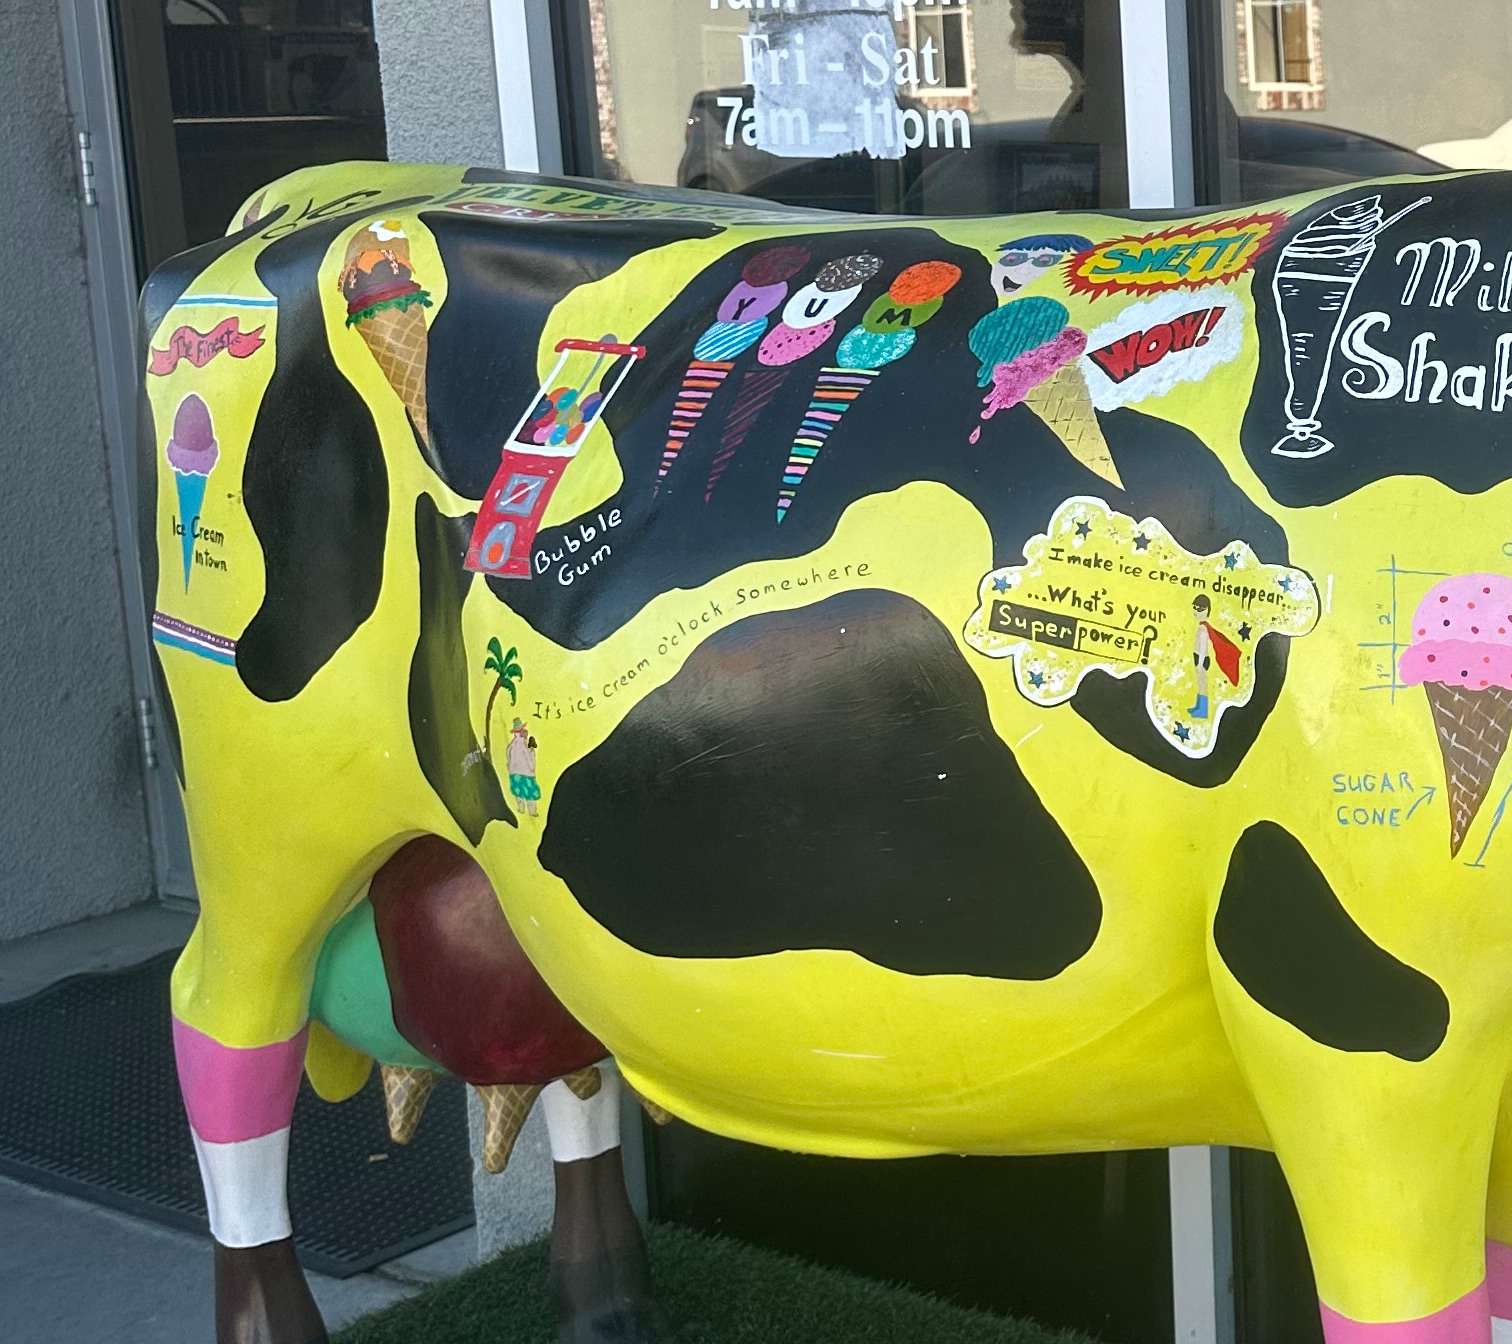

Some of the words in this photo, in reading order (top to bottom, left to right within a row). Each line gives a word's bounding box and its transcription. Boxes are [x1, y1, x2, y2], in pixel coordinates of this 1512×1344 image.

[738, 34, 811, 86] Fri
[860, 31, 941, 86] Sat
[716, 96, 811, 146] 7am
[854, 98, 973, 157] 11pm
[1087, 306, 1227, 384] WOW!
[191, 515, 225, 548] Cream
[535, 508, 622, 574] Bubble
[558, 544, 611, 586] Gum
[1066, 553, 1113, 572] make
[1119, 556, 1142, 577] ice
[1148, 569, 1206, 589] cream
[1126, 603, 1167, 629] your
[532, 701, 562, 719] It's
[1332, 771, 1415, 793] SUGAR
